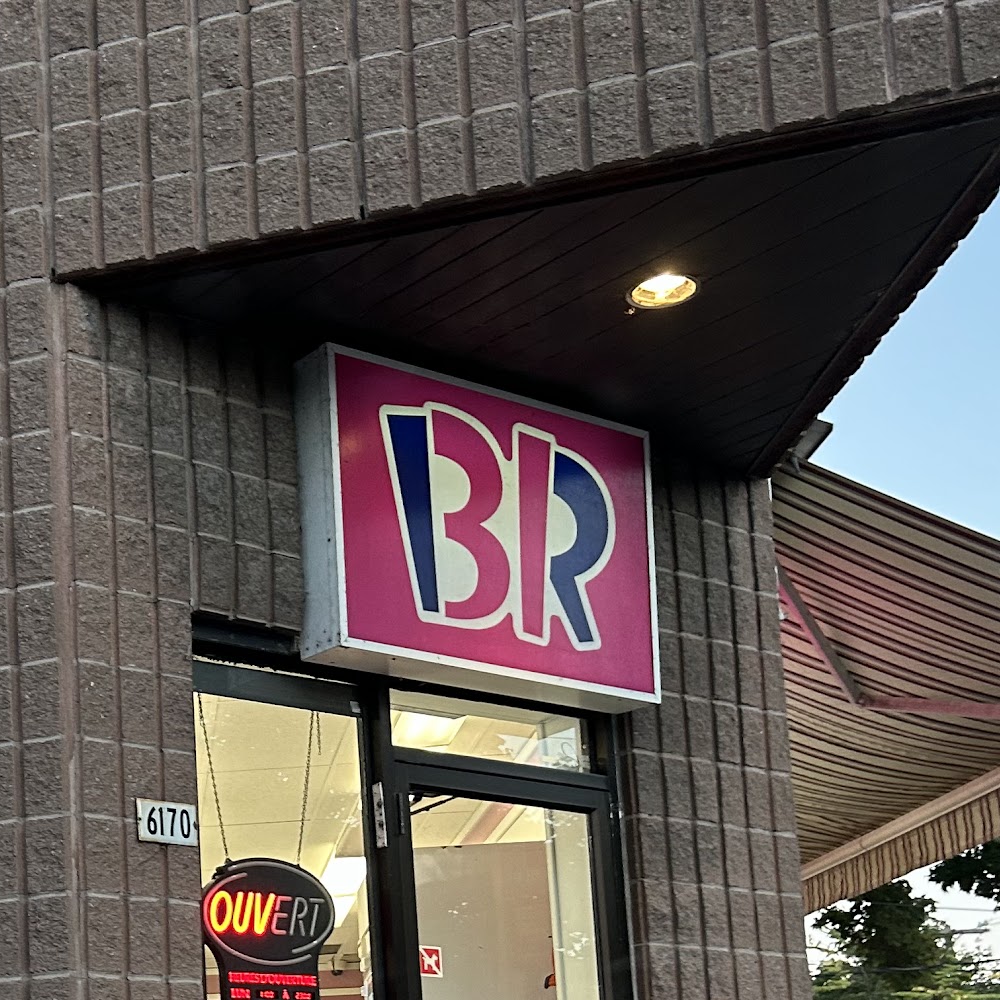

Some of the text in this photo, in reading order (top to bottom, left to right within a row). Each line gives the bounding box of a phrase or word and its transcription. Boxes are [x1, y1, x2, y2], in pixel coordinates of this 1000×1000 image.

[382, 404, 613, 648] BR
[146, 805, 192, 839] 6170
[208, 890, 325, 937] OUVERT
